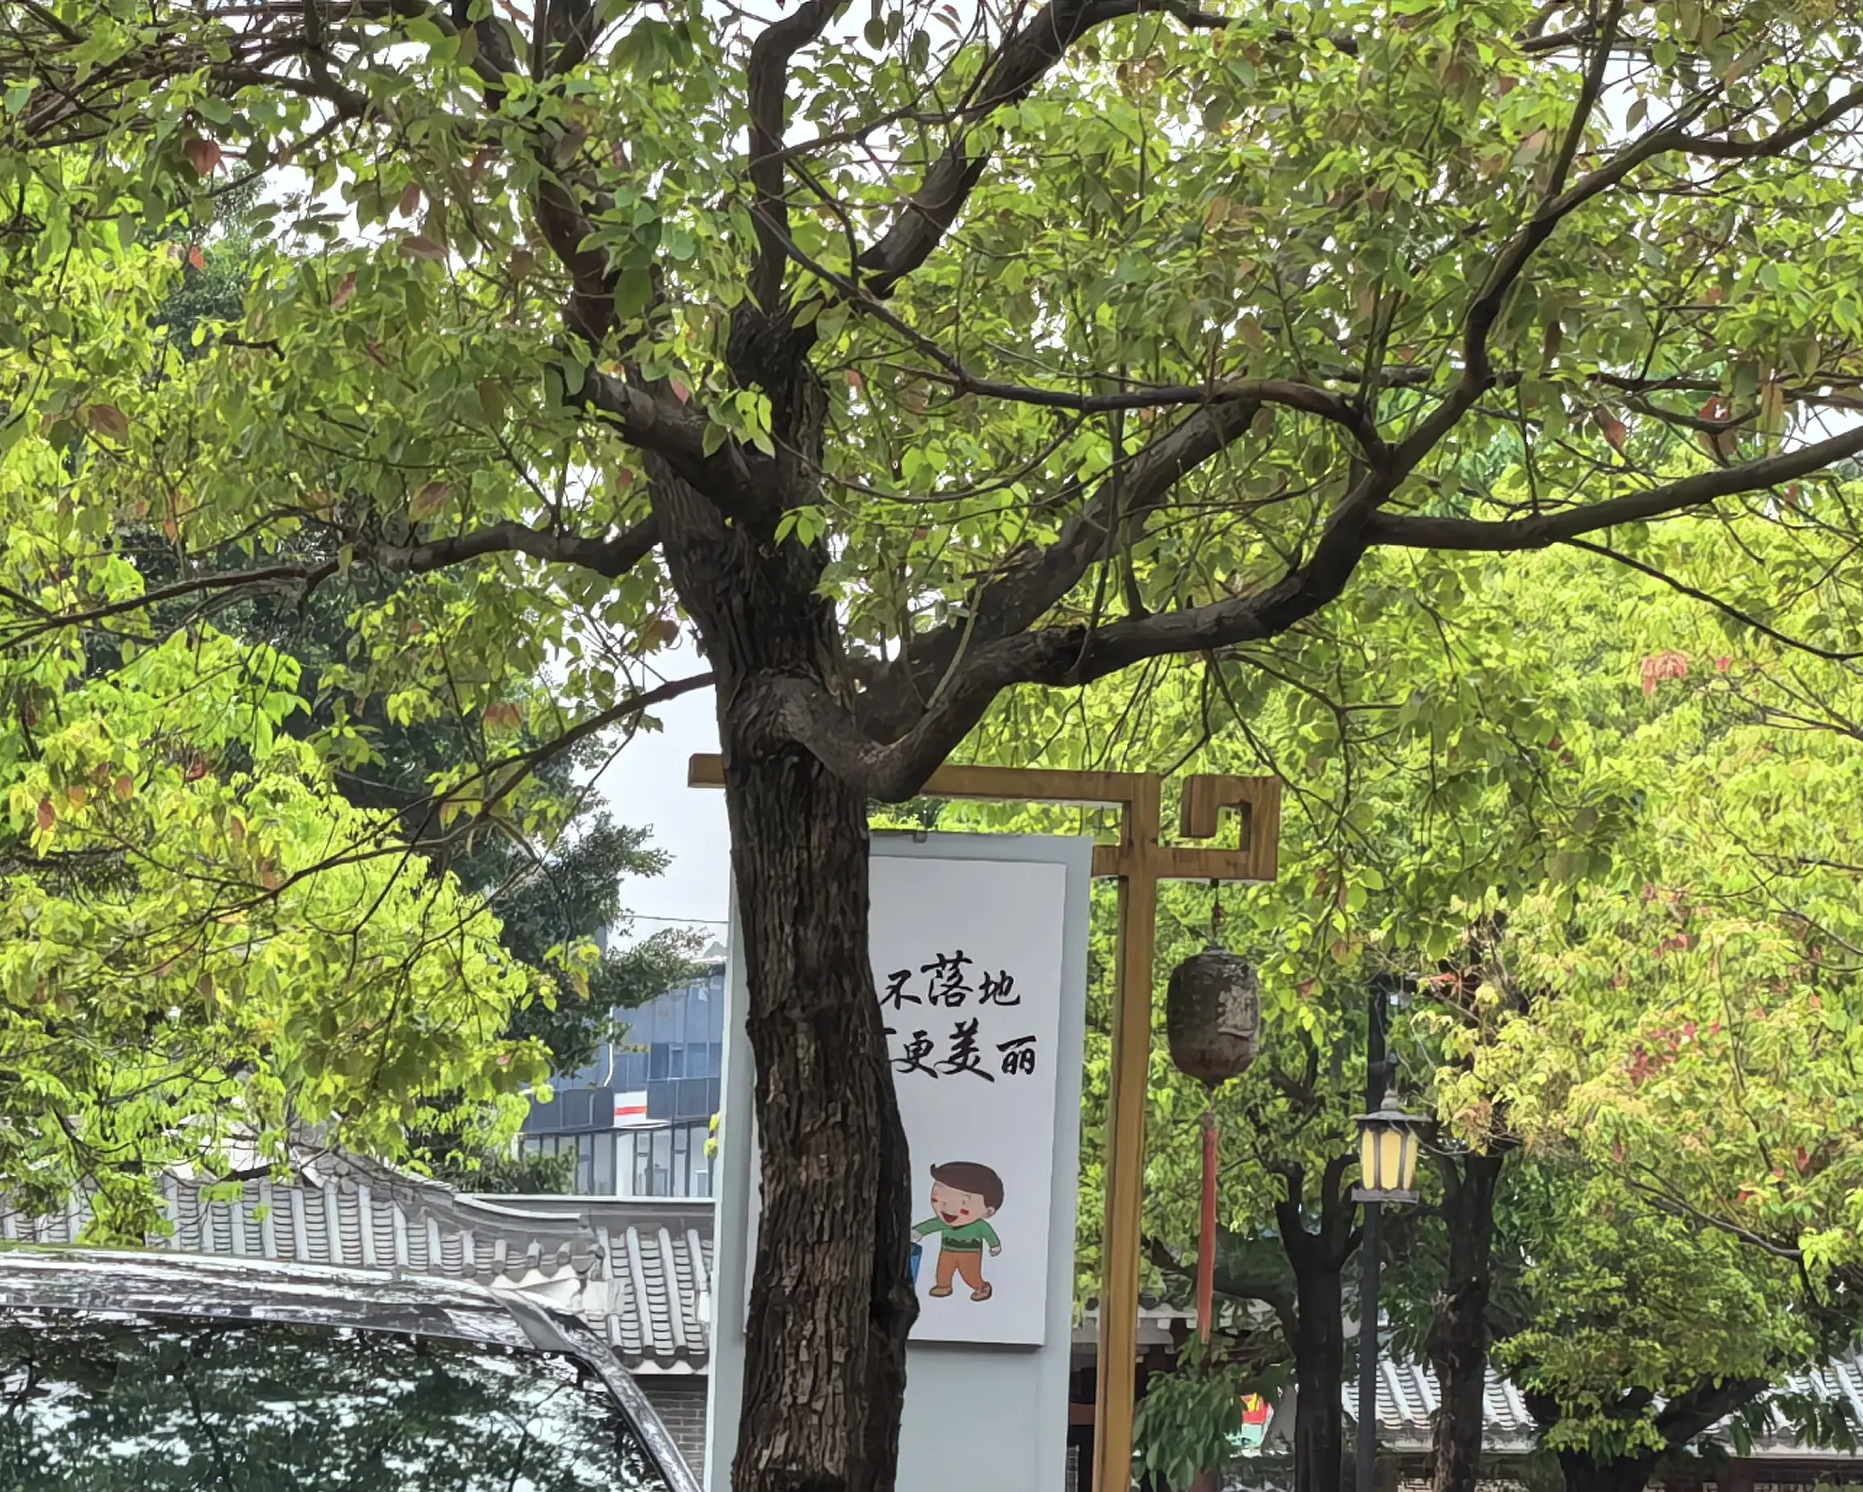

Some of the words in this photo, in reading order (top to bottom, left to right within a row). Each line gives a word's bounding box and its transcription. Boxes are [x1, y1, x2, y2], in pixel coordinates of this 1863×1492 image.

[880, 950, 1020, 1010] 不落地
[884, 1017, 1037, 1082] 更美丽
